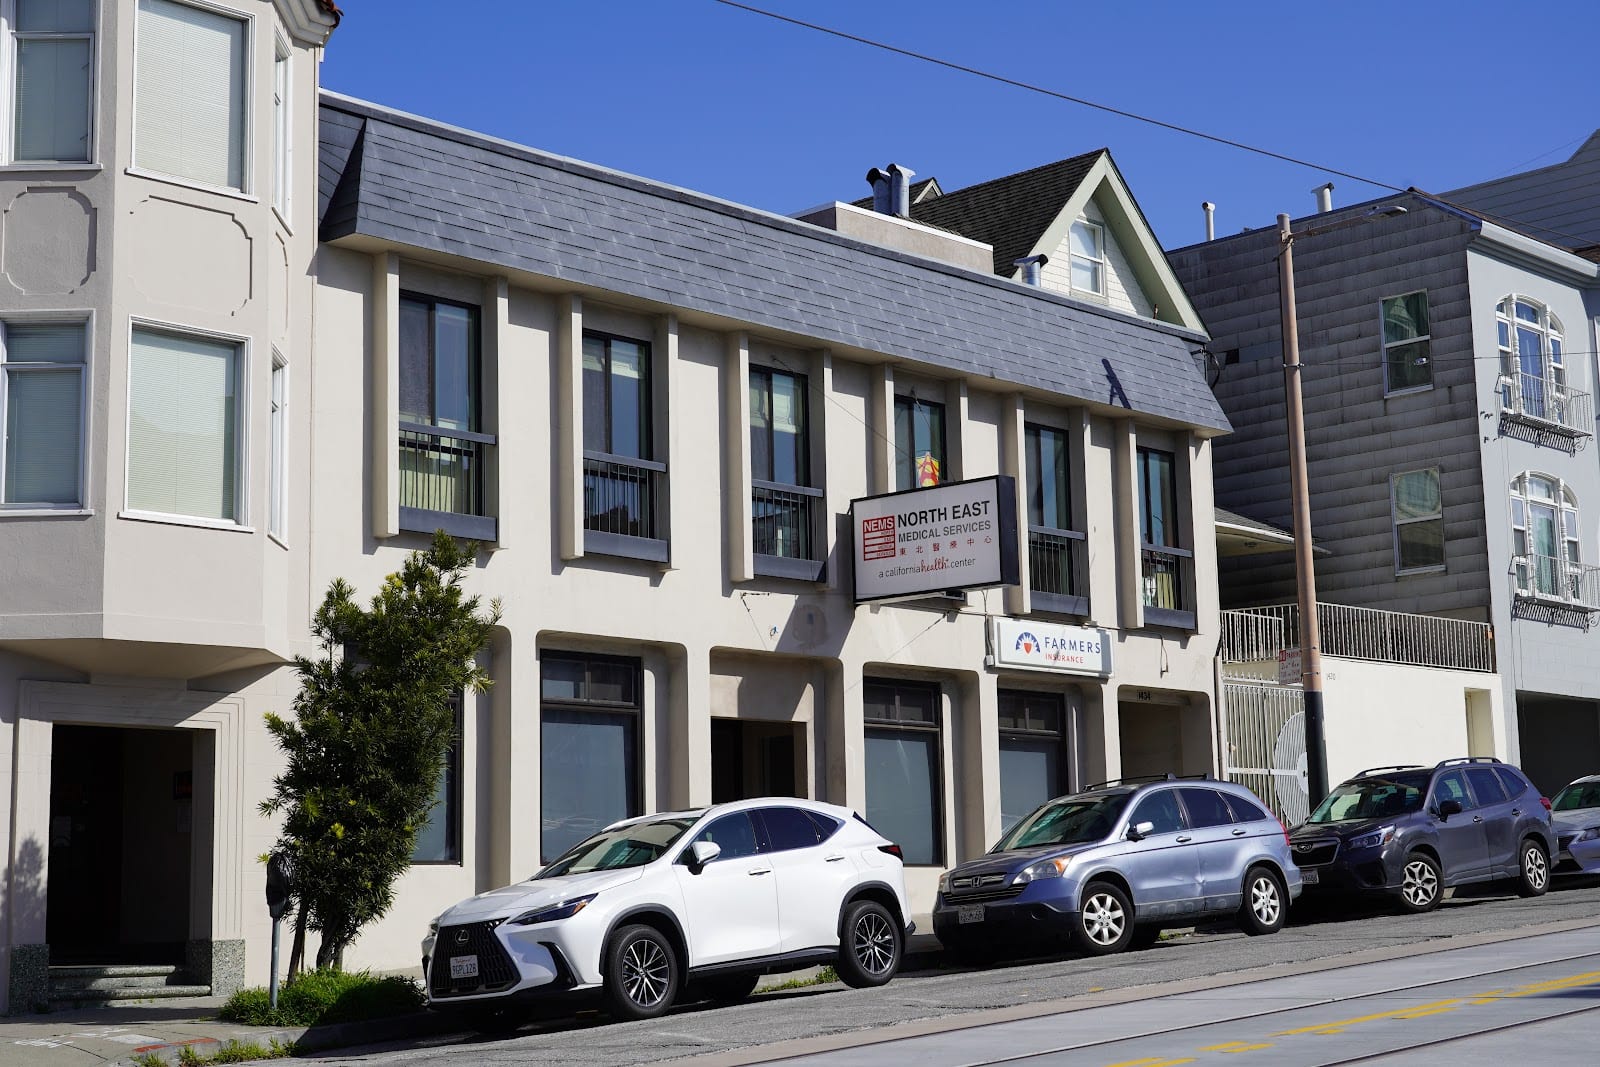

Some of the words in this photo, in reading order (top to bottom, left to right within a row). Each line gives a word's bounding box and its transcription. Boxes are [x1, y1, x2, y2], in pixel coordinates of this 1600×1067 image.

[898, 507, 947, 528] NORTH
[952, 500, 991, 520] EAST
[864, 518, 894, 533] NEMS
[898, 528, 941, 543] MEDICAL
[943, 520, 991, 536] SERVICES
[878, 570, 884, 578] a
[885, 564, 921, 578] california
[950, 557, 977, 569] center
[1044, 636, 1101, 654] FARMERS
[1045, 653, 1084, 664] INSURANCE
